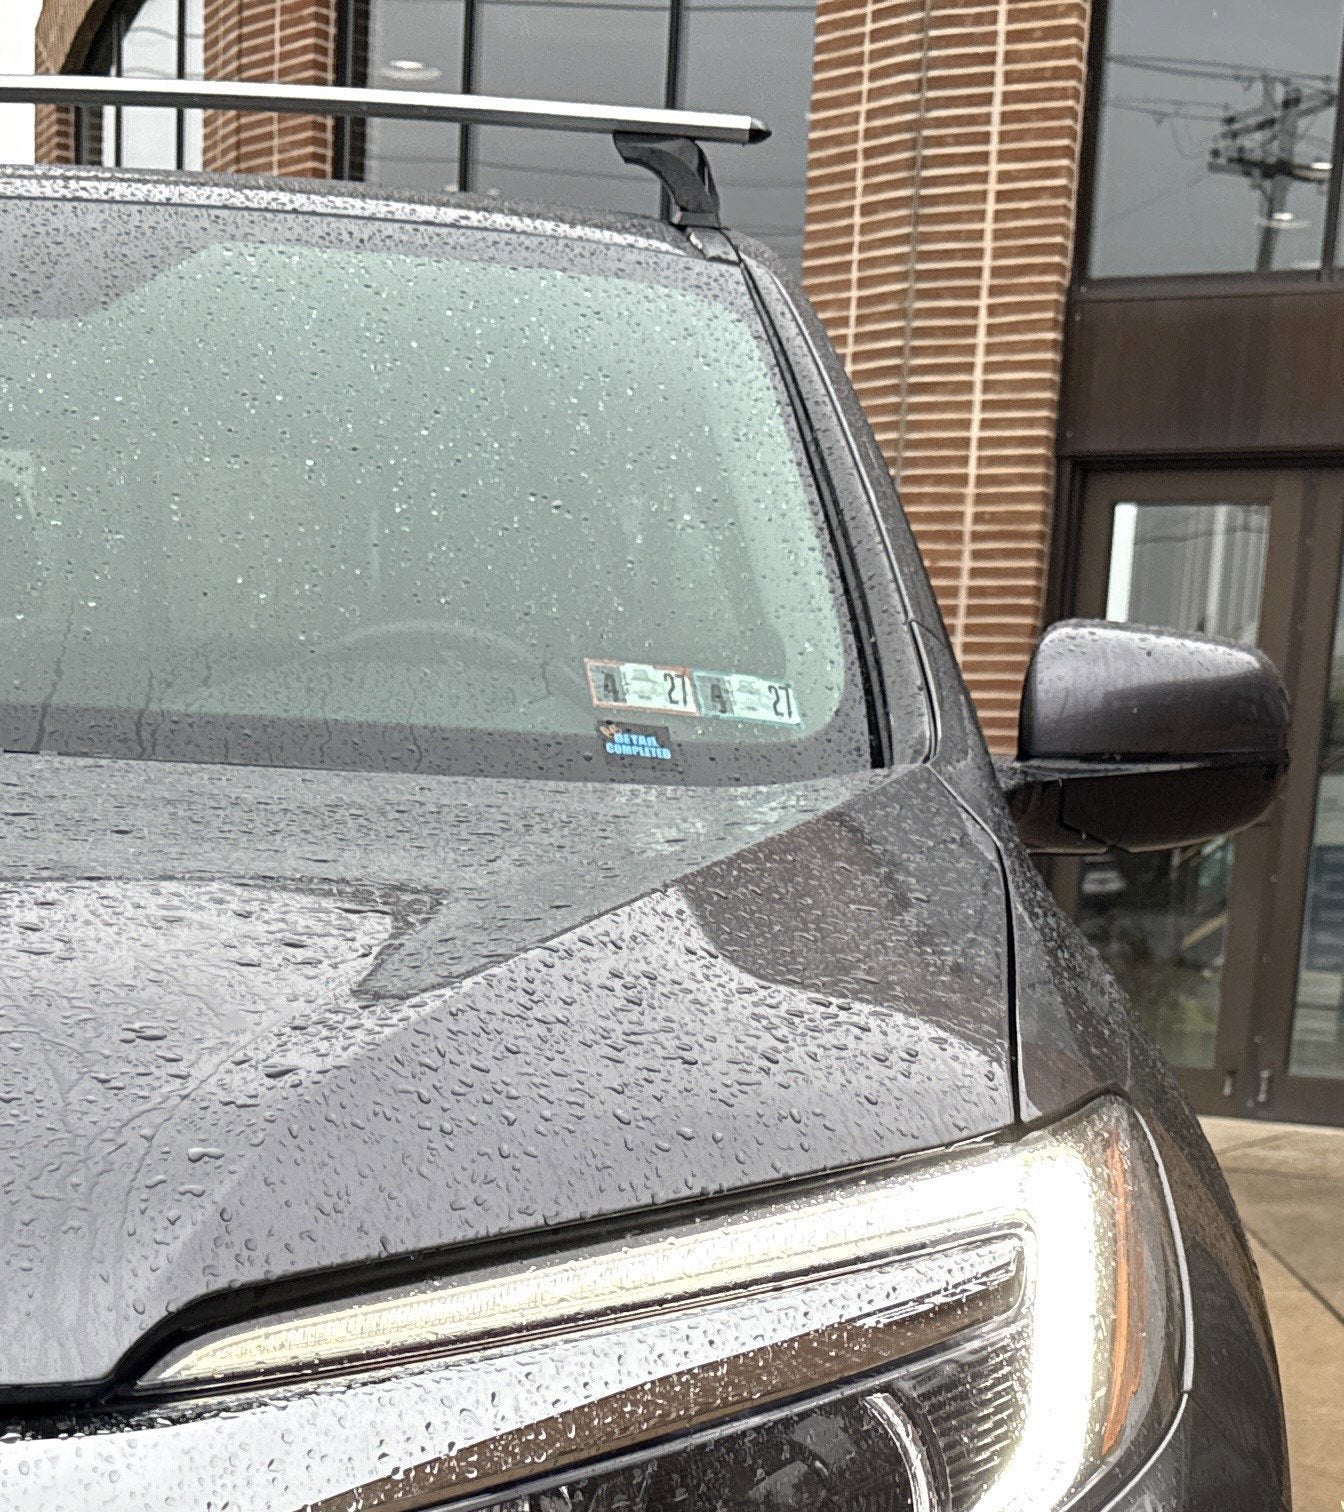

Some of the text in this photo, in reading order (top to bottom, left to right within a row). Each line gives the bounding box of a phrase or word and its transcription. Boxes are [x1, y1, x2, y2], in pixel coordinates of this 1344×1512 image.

[663, 672, 688, 707] 27
[767, 684, 793, 719] 27
[613, 732, 660, 747] DETAIL
